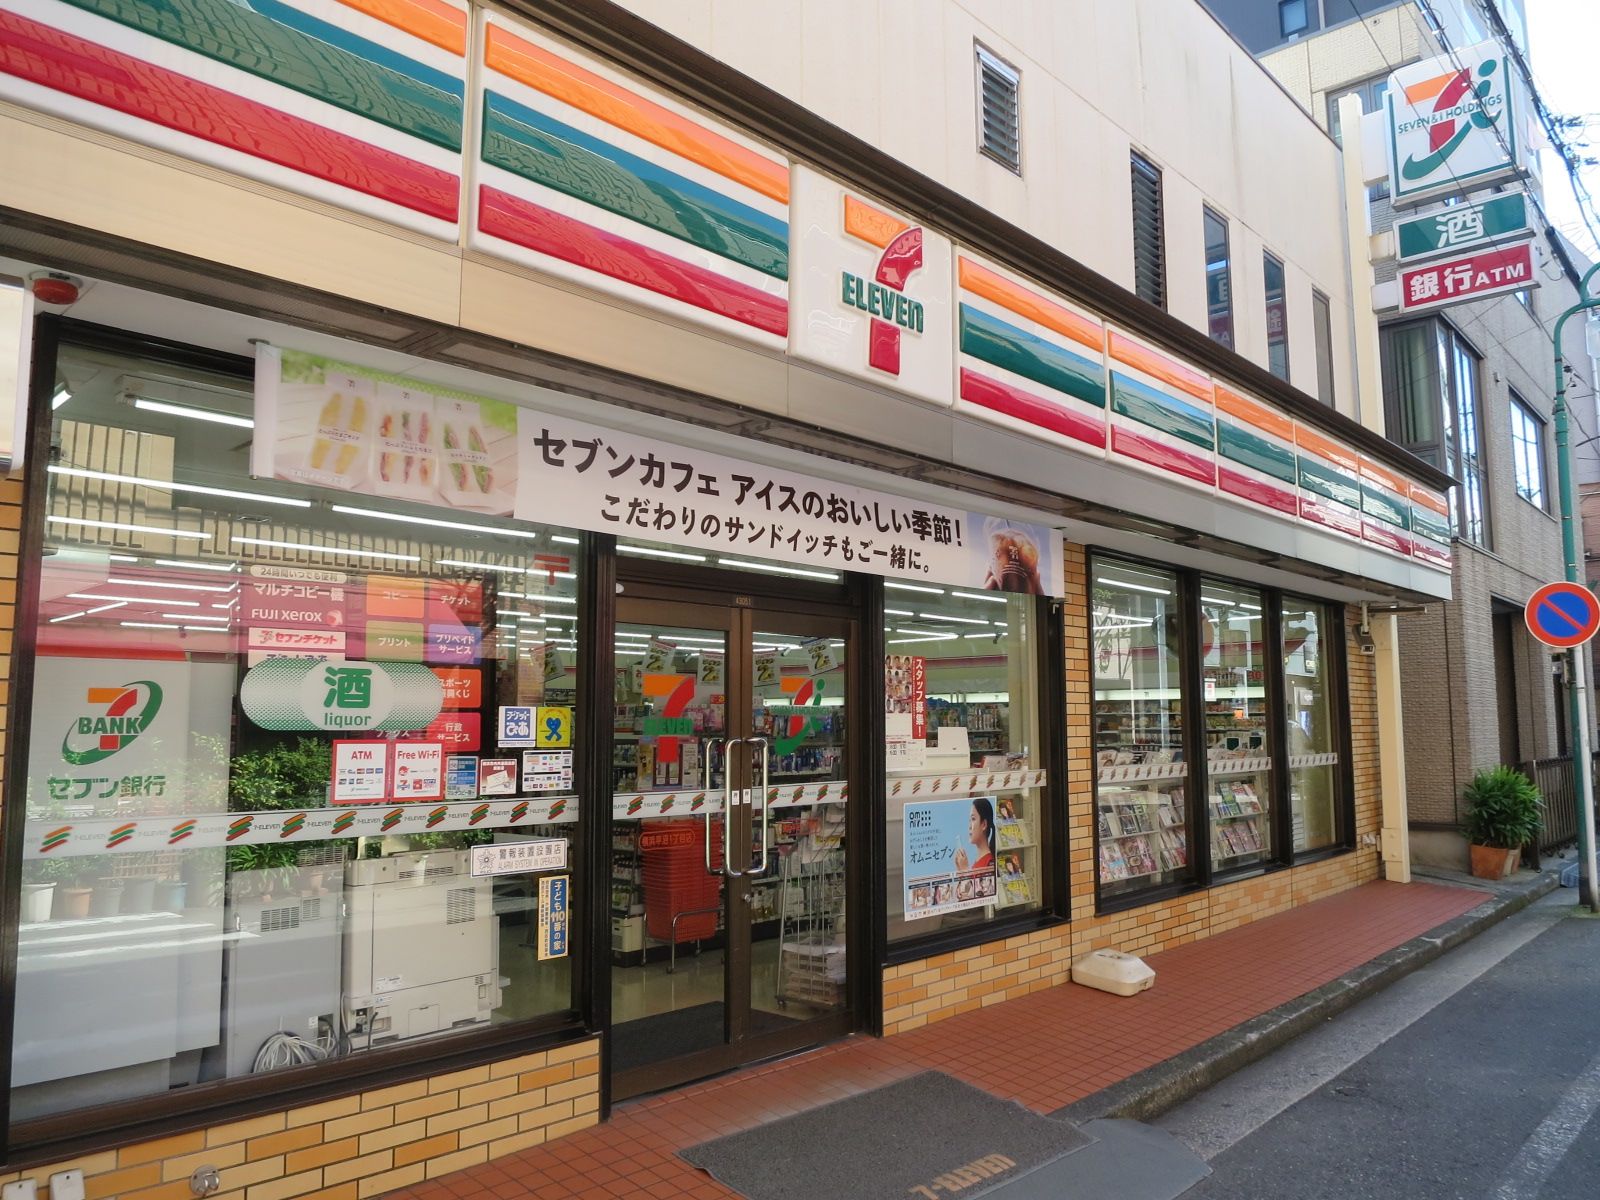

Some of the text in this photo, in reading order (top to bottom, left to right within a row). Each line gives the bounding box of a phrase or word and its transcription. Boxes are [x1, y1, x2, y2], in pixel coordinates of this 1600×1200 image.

[1436, 205, 1484, 249] 酒
[533, 428, 720, 497] セブンカフェ
[600, 494, 930, 574] こだわりのサンドイッチもご一緒に。
[253, 582, 345, 602] マルチコピー機
[440, 596, 471, 606] チケット
[251, 608, 279, 620] FUJI
[275, 632, 337, 645] セブンチケット
[378, 637, 412, 648] プリント
[438, 645, 472, 655] サービス
[323, 666, 372, 709] 酒
[78, 716, 141, 735] BANK
[324, 712, 371, 728] liquor
[436, 733, 471, 742] サービス
[351, 750, 373, 760] ATM
[398, 750, 440, 760] Free Wi-Fi
[47, 775, 166, 800] セブン銀行
[909, 846, 956, 864] オムニセブン
